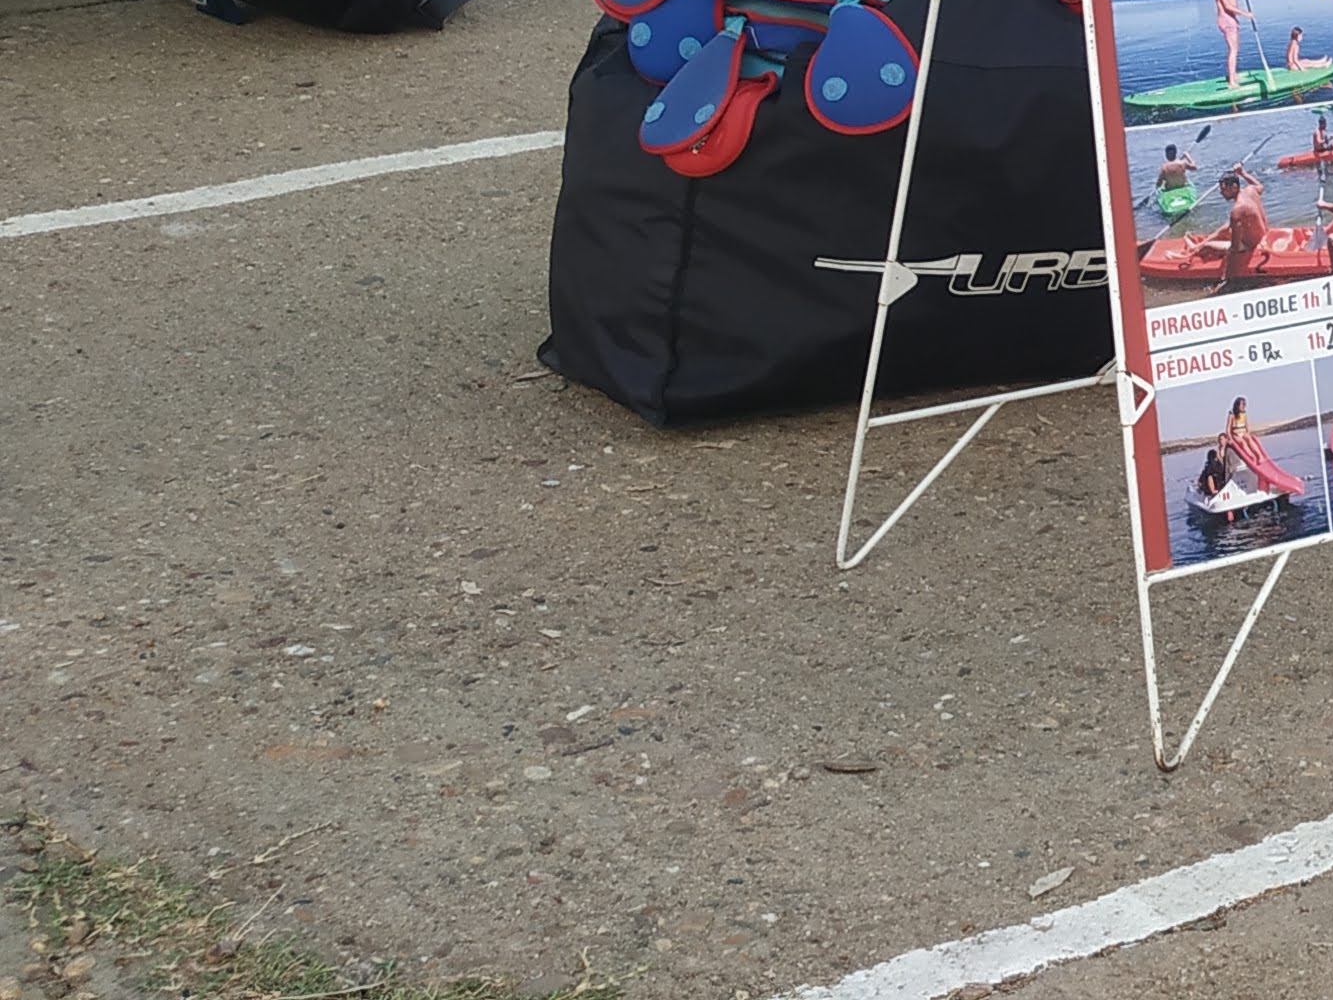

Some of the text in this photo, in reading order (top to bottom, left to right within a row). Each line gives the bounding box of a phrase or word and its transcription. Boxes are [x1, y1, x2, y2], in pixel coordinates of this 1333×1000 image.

[1151, 308, 1228, 338] PIRAGUA
[1243, 295, 1298, 320] DOBLE
[1302, 292, 1320, 309] 1h
[1156, 349, 1233, 380] PÉDALOS
[1248, 345, 1258, 361] 6
[1307, 333, 1326, 351] 1h
